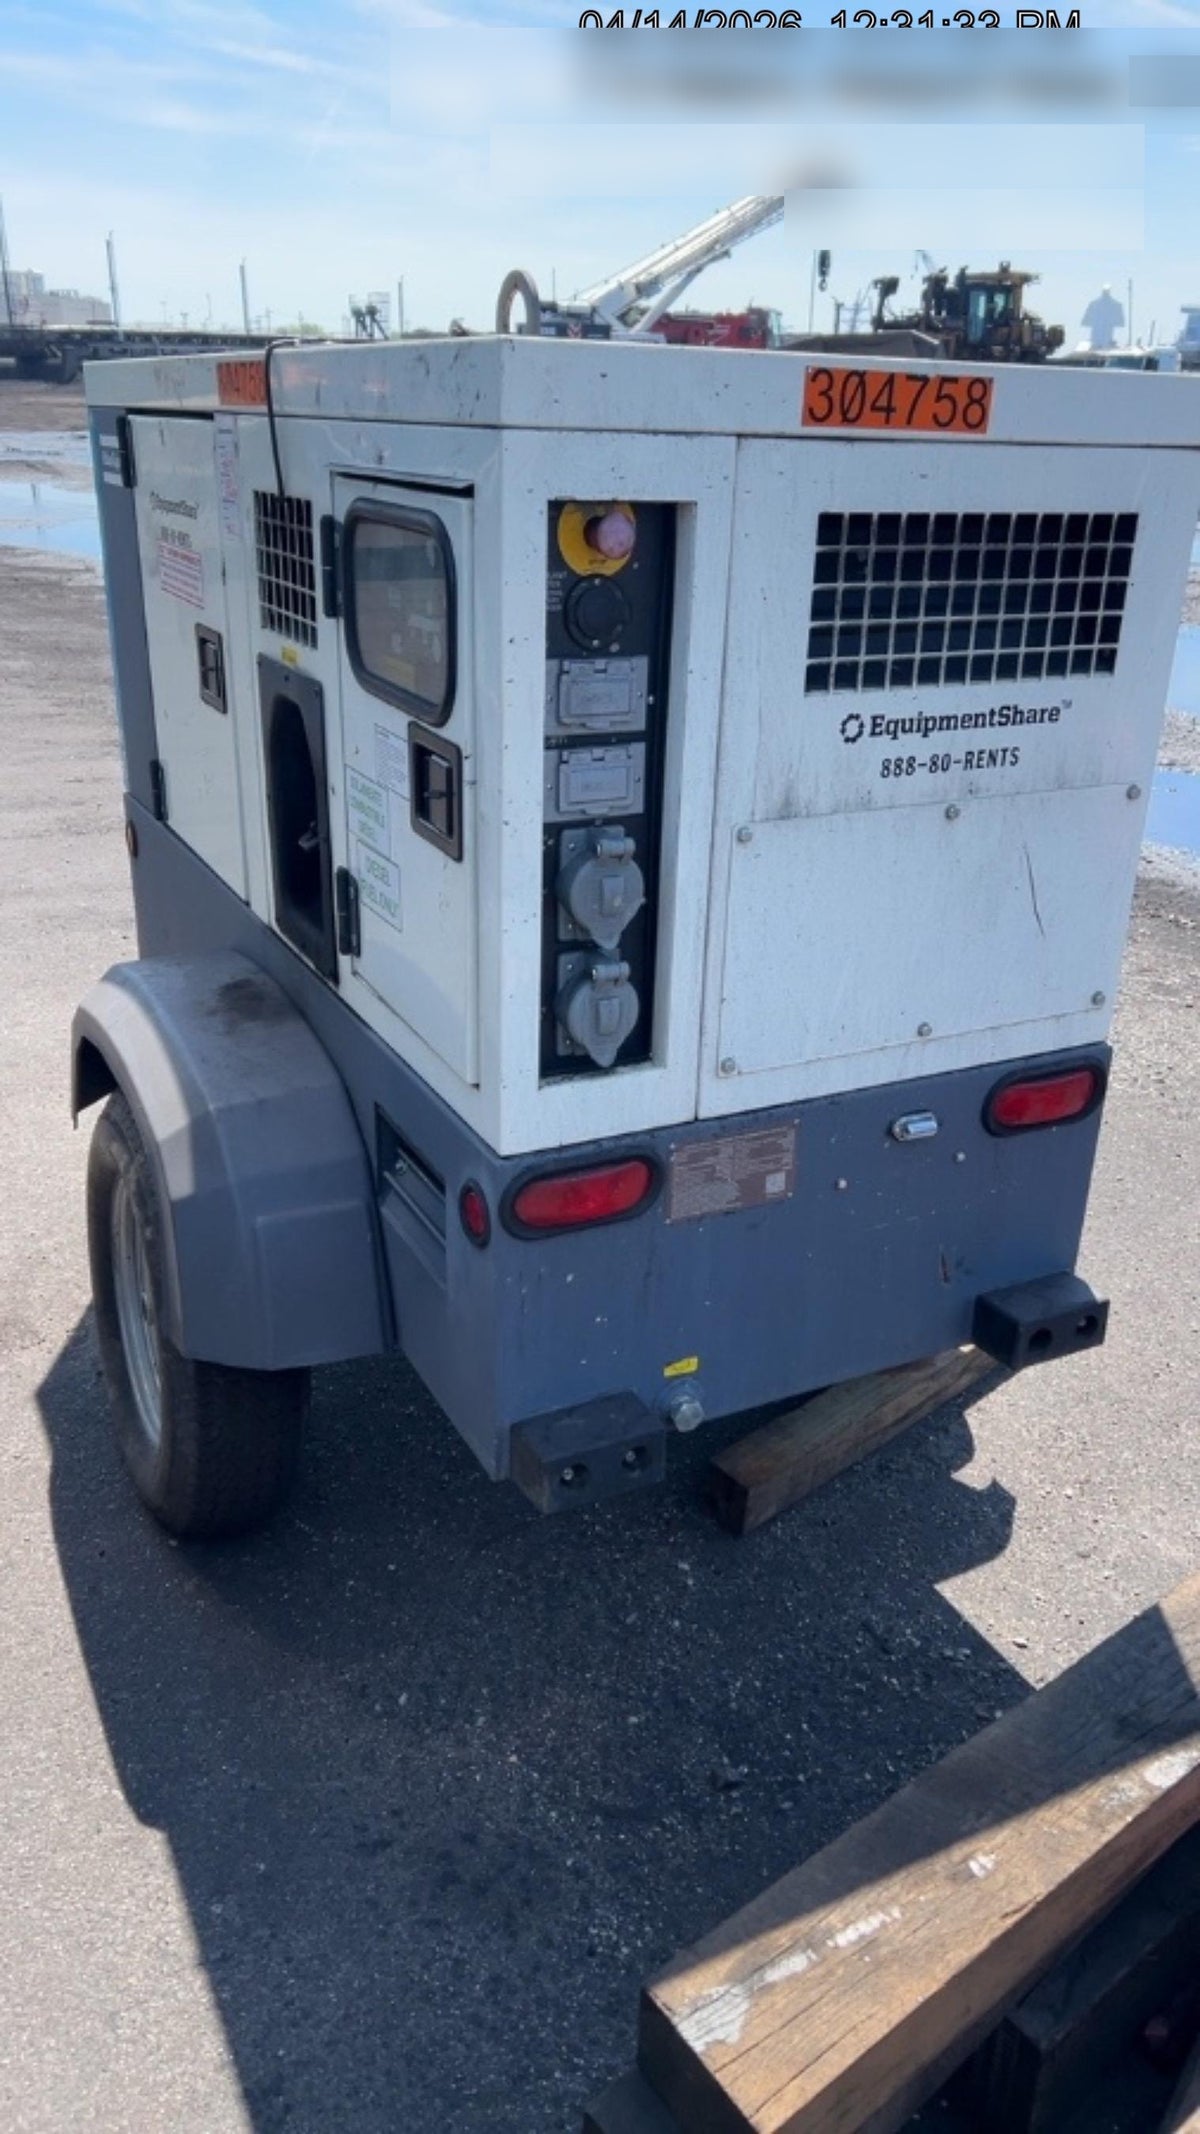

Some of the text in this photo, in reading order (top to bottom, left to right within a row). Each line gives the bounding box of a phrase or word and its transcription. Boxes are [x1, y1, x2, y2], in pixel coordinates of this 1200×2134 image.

[808, 368, 988, 429] 304758
[868, 705, 1061, 740] EquipmentShare
[879, 746, 1020, 779] 888-80-RENTS
